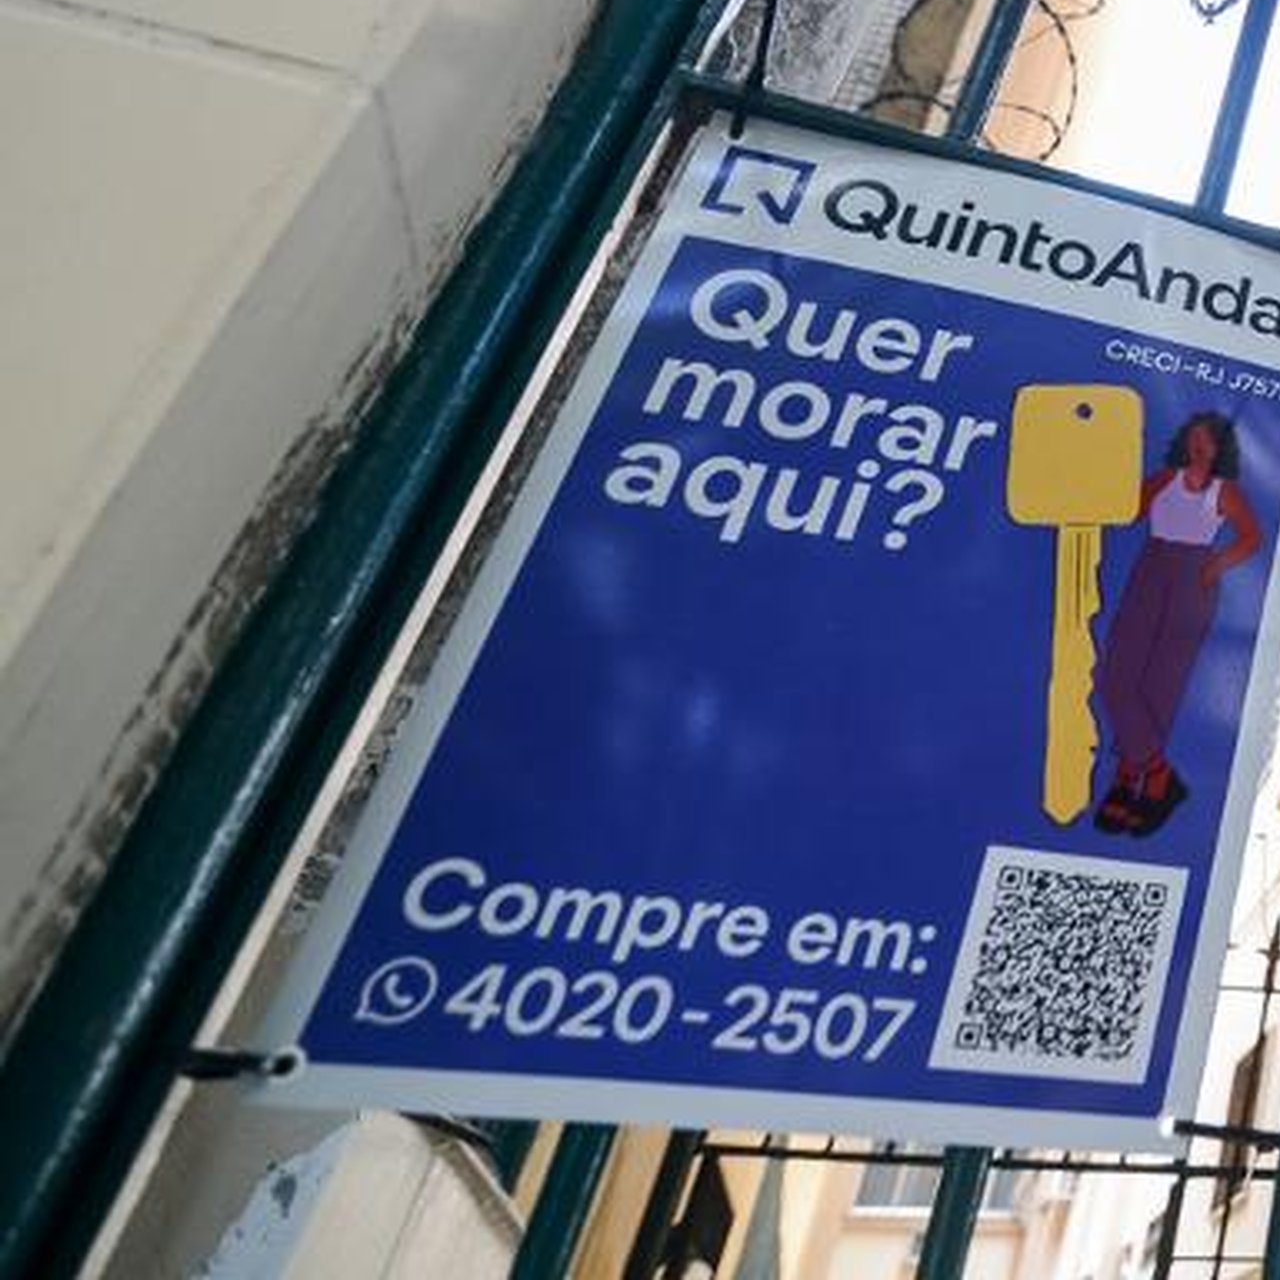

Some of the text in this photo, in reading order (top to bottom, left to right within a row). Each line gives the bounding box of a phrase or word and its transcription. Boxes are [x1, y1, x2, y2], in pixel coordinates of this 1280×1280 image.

[689, 268, 974, 381] Quer
[1105, 339, 1225, 385] CRECI-RJ
[642, 357, 998, 473] morar
[603, 440, 946, 550] aqui?
[403, 857, 937, 974] Compre em:
